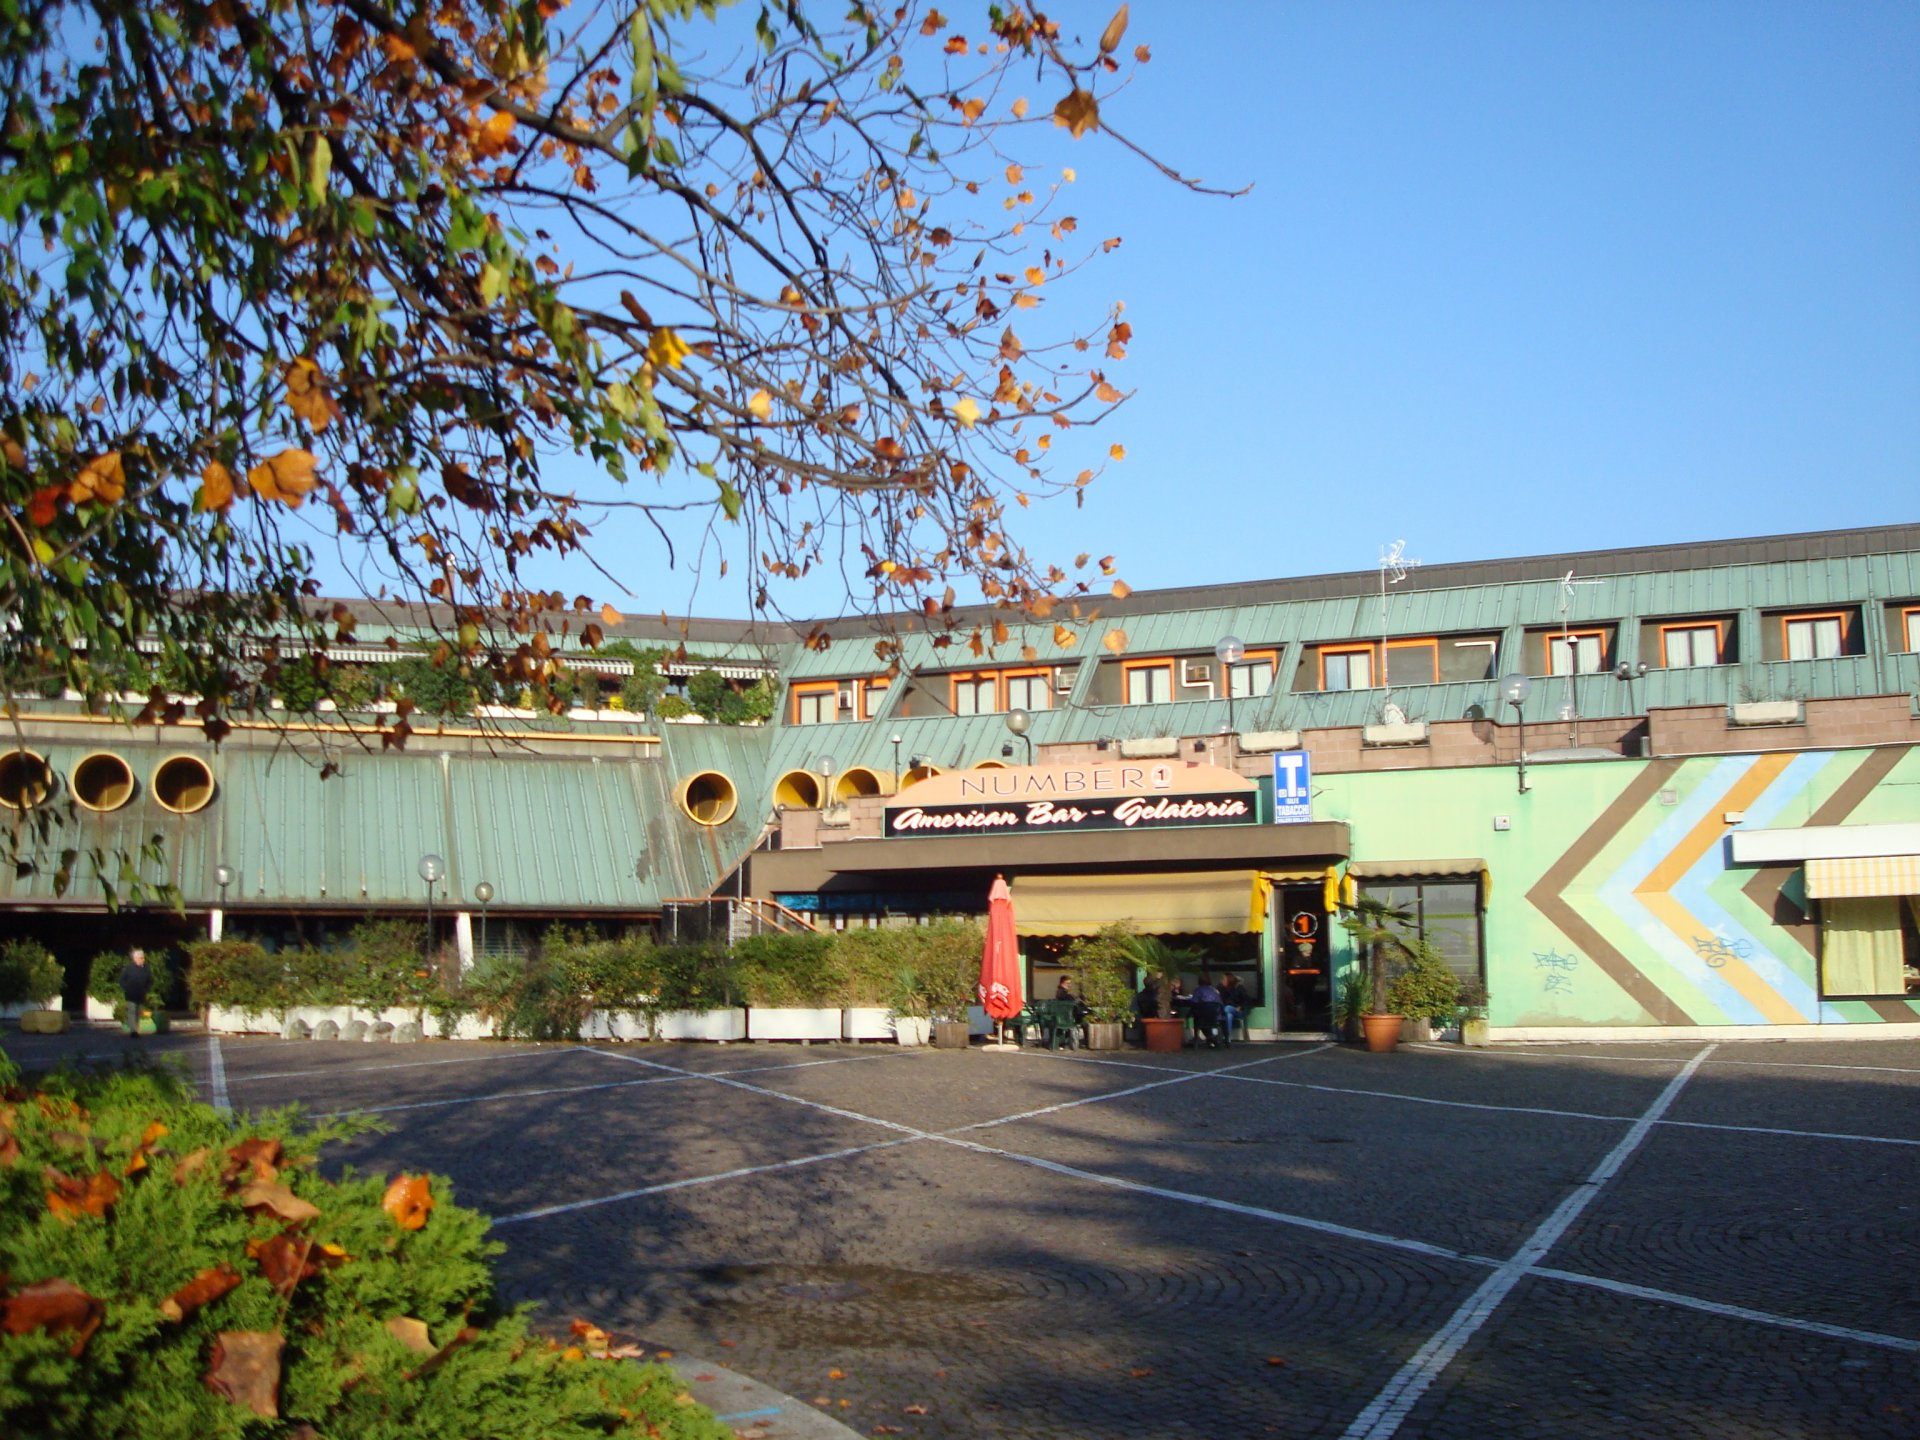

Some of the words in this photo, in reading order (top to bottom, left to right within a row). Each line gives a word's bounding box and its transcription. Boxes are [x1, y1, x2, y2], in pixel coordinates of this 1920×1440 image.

[961, 768, 1144, 797] NUMBER
[1279, 755, 1303, 798] T
[892, 807, 1019, 831] American
[1025, 801, 1088, 825] Bar
[1112, 797, 1249, 827] Gelateria
[1277, 804, 1310, 816] TABACCHI
[1296, 915, 1309, 934] 1
